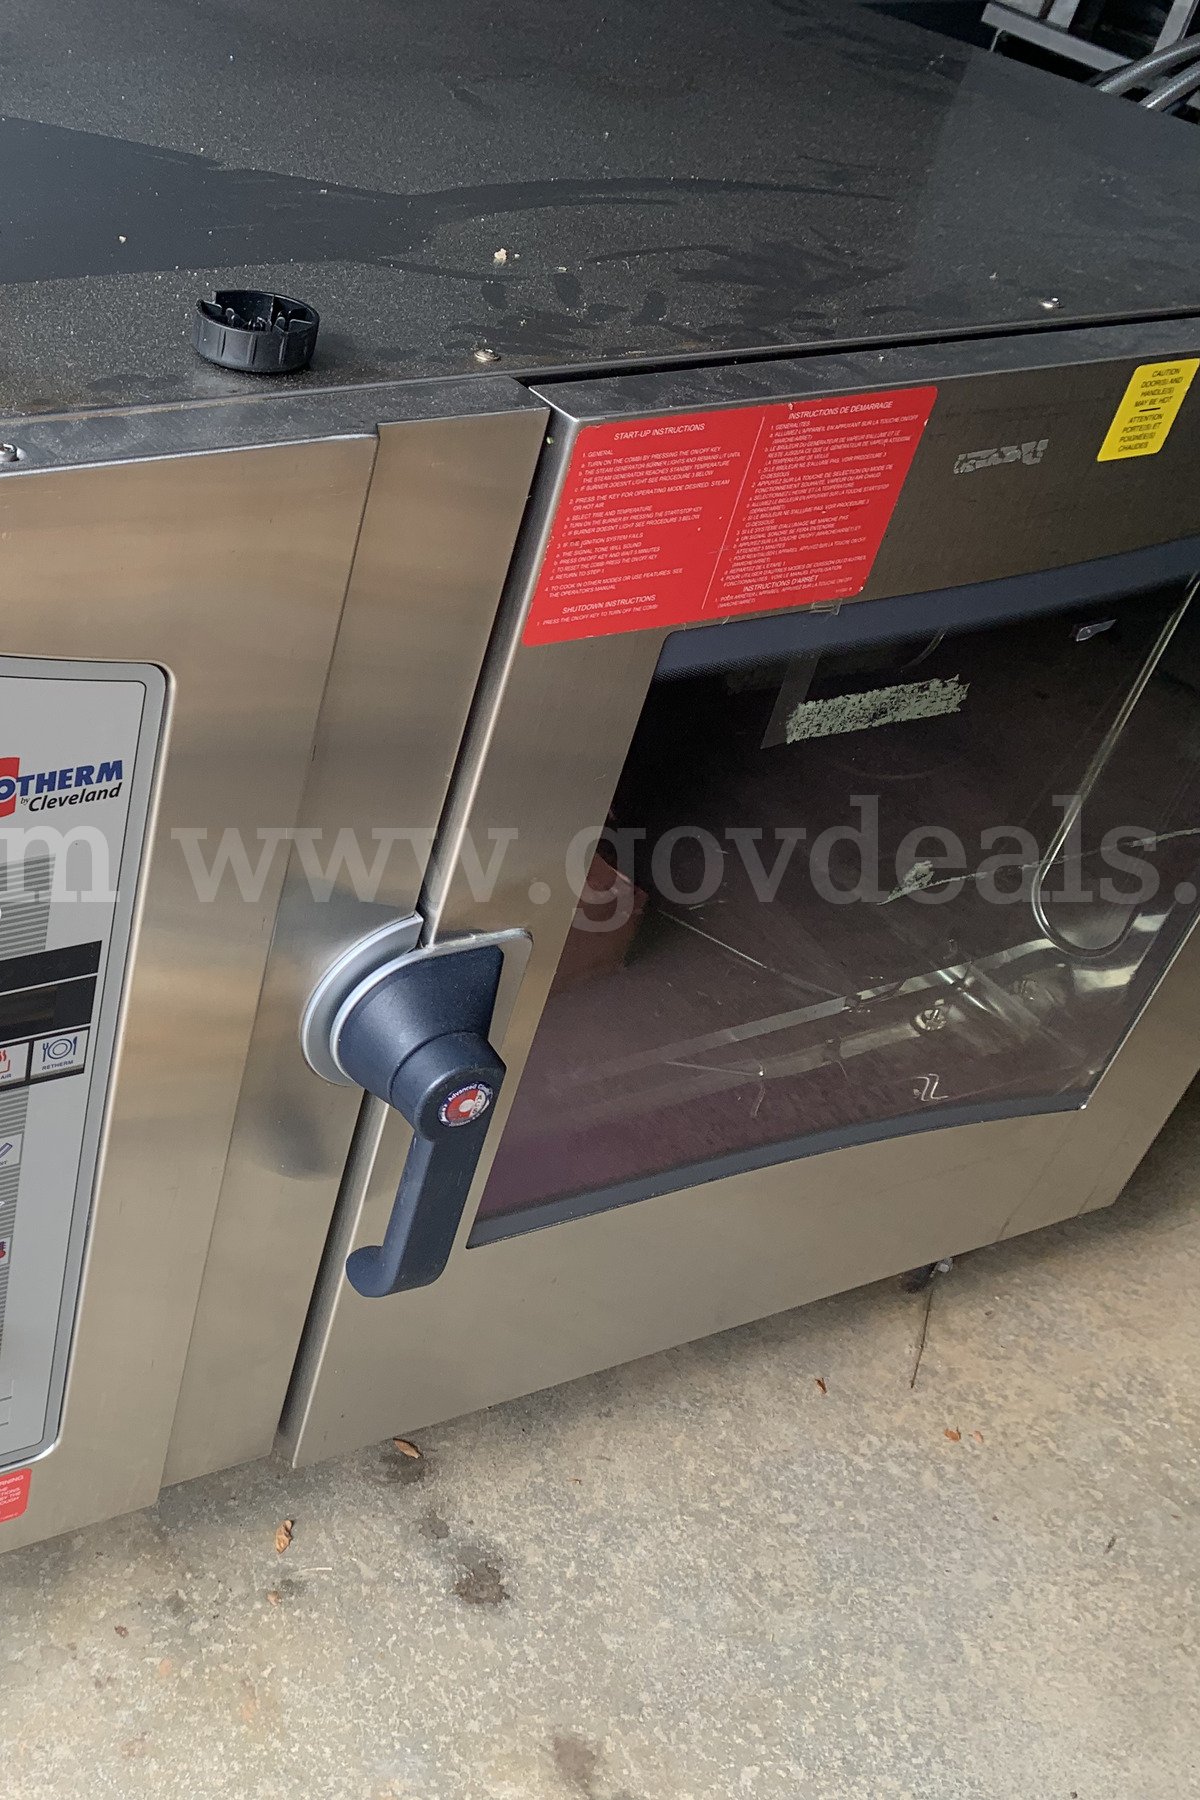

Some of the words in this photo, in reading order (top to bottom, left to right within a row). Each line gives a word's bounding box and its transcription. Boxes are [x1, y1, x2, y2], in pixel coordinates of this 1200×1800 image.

[1152, 368, 1181, 378] CAUTION
[788, 406, 840, 420] INSTRUCTIONS
[839, 405, 850, 414] DE
[1128, 414, 1164, 423] ATTENTION
[613, 429, 651, 441] START-UP
[651, 422, 706, 436] INSTRUCTIONS
[742, 578, 791, 591] INSTRUCTIONS
[561, 601, 604, 613] SHUTDOWN
[604, 594, 657, 607] INSTRUCTIONS
[20, 797, 31, 806] by
[28, 782, 122, 812] Cleveland
[41, 1060, 74, 1071] RETHERM
